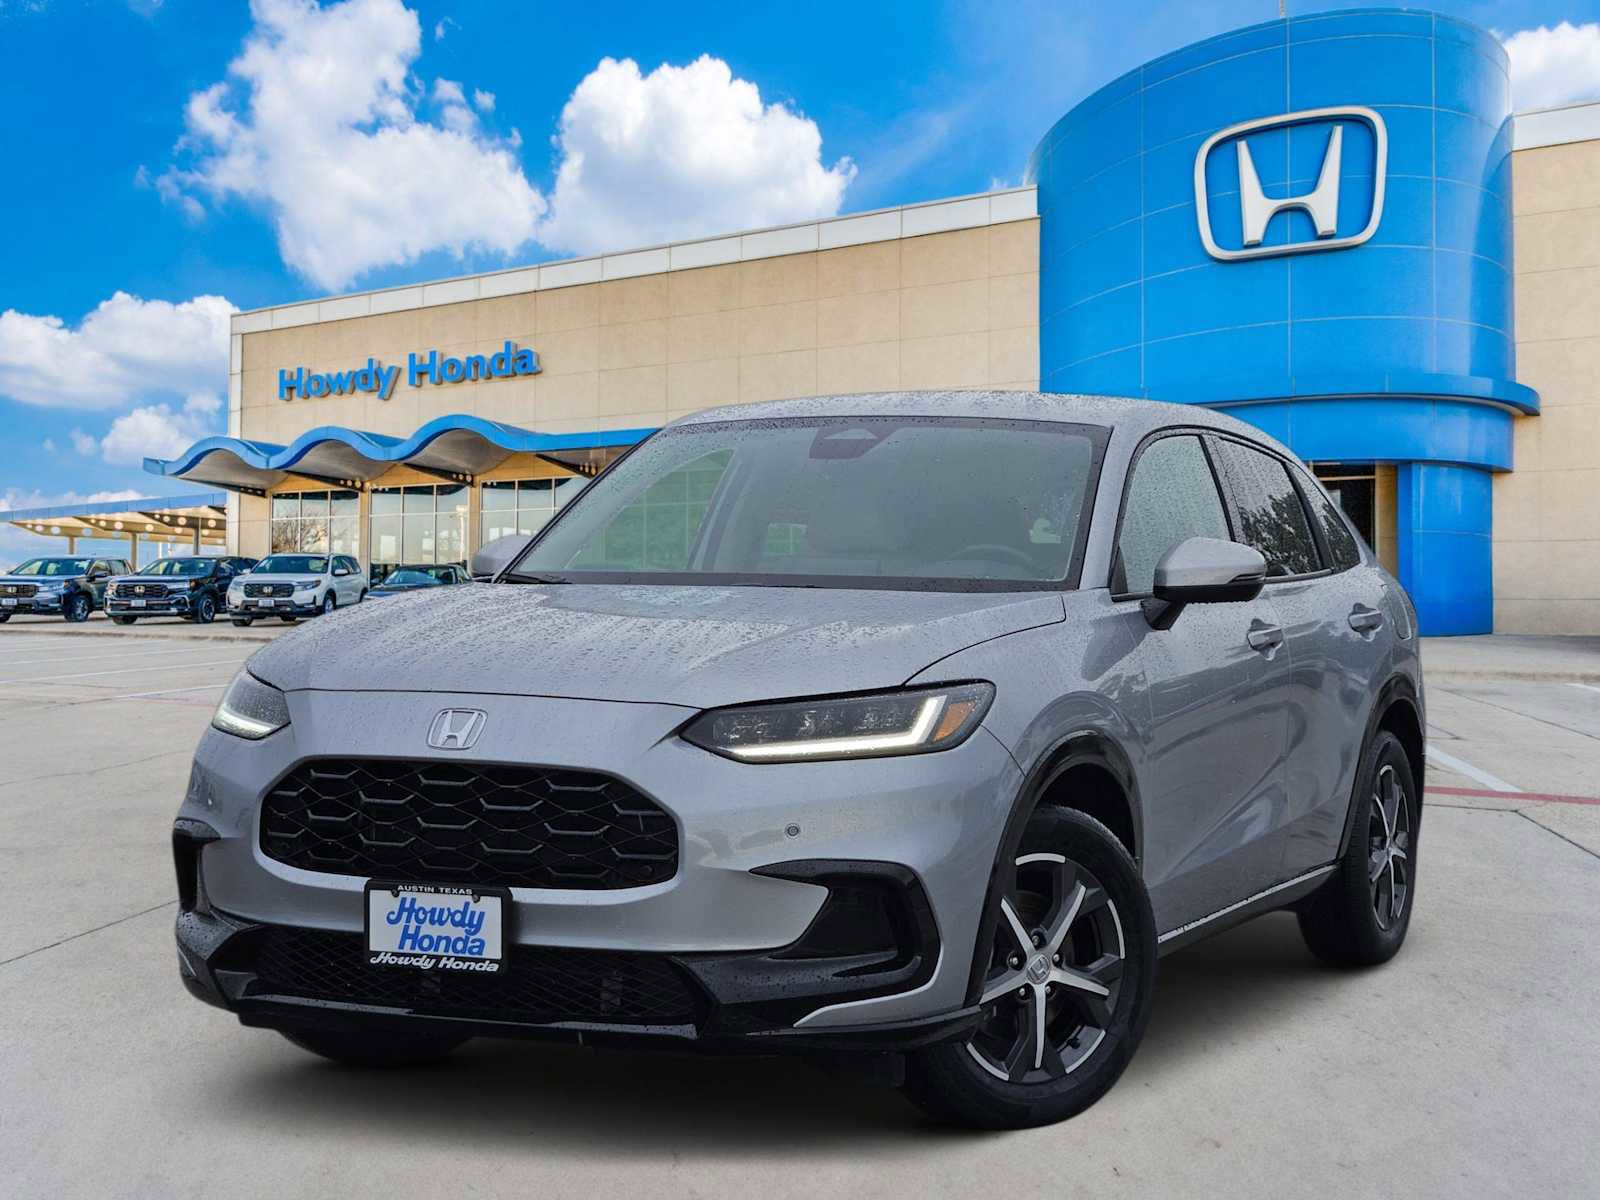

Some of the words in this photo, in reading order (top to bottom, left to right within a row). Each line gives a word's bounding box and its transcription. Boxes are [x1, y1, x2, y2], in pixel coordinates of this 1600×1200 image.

[278, 358, 399, 400] Howdy
[408, 341, 541, 387] Honda
[397, 885, 435, 893] AUSTIN
[439, 887, 473, 895] TEXAS
[386, 897, 485, 936] Howdy
[398, 924, 486, 956] Honda
[370, 952, 436, 969] Howdy
[439, 957, 499, 972] Honda
